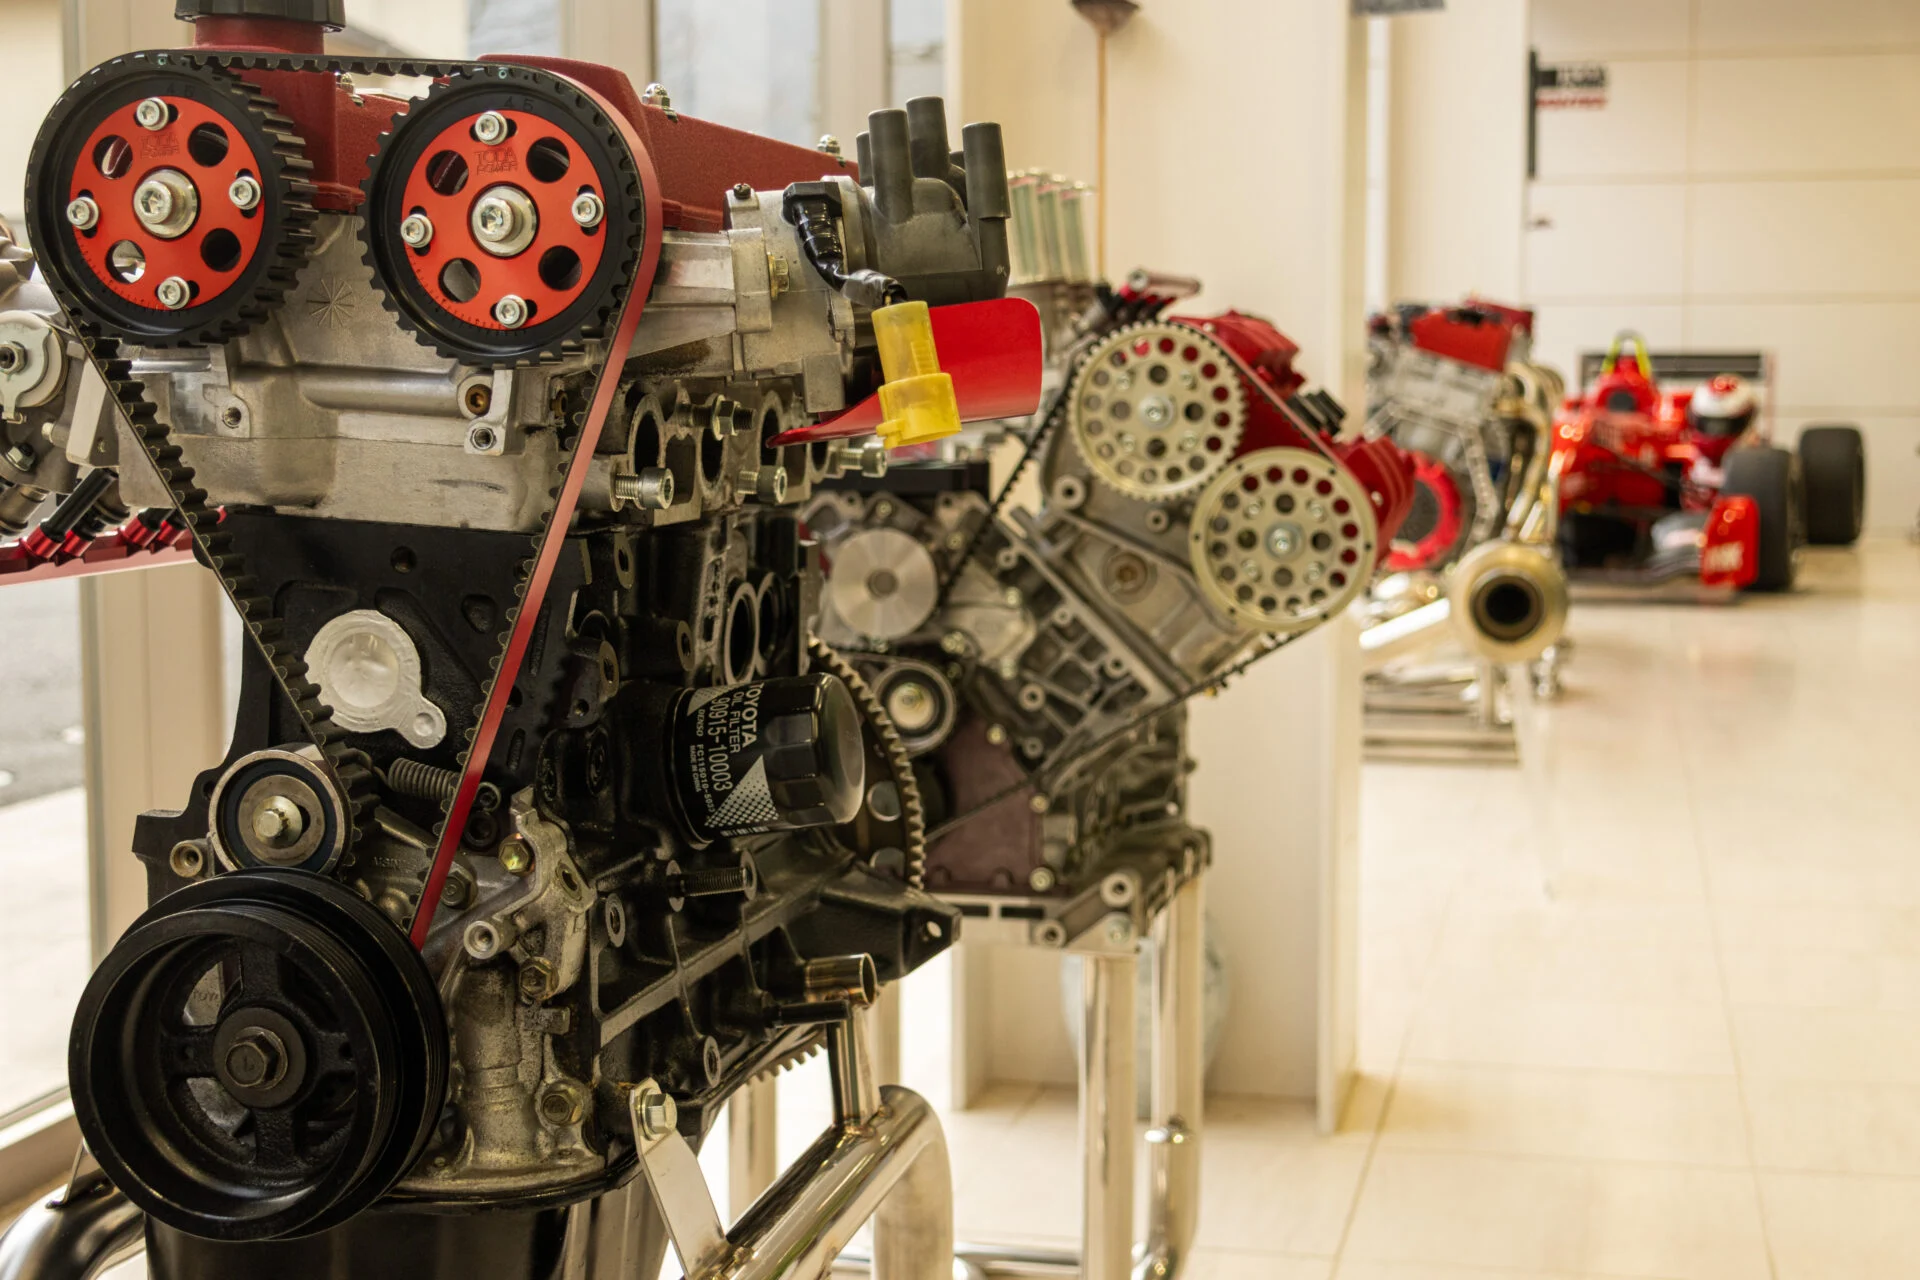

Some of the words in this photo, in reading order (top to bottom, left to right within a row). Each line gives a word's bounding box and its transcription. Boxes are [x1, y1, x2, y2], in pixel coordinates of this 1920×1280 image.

[474, 147, 517, 164] TODA
[476, 161, 518, 175] POWER
[731, 691, 744, 707] OIL
[696, 709, 706, 737] DENSO
[742, 683, 764, 748] TOYOTA
[729, 710, 741, 753] FILTER
[707, 697, 733, 791] 90915-10003
[693, 773, 701, 792] CHINA
